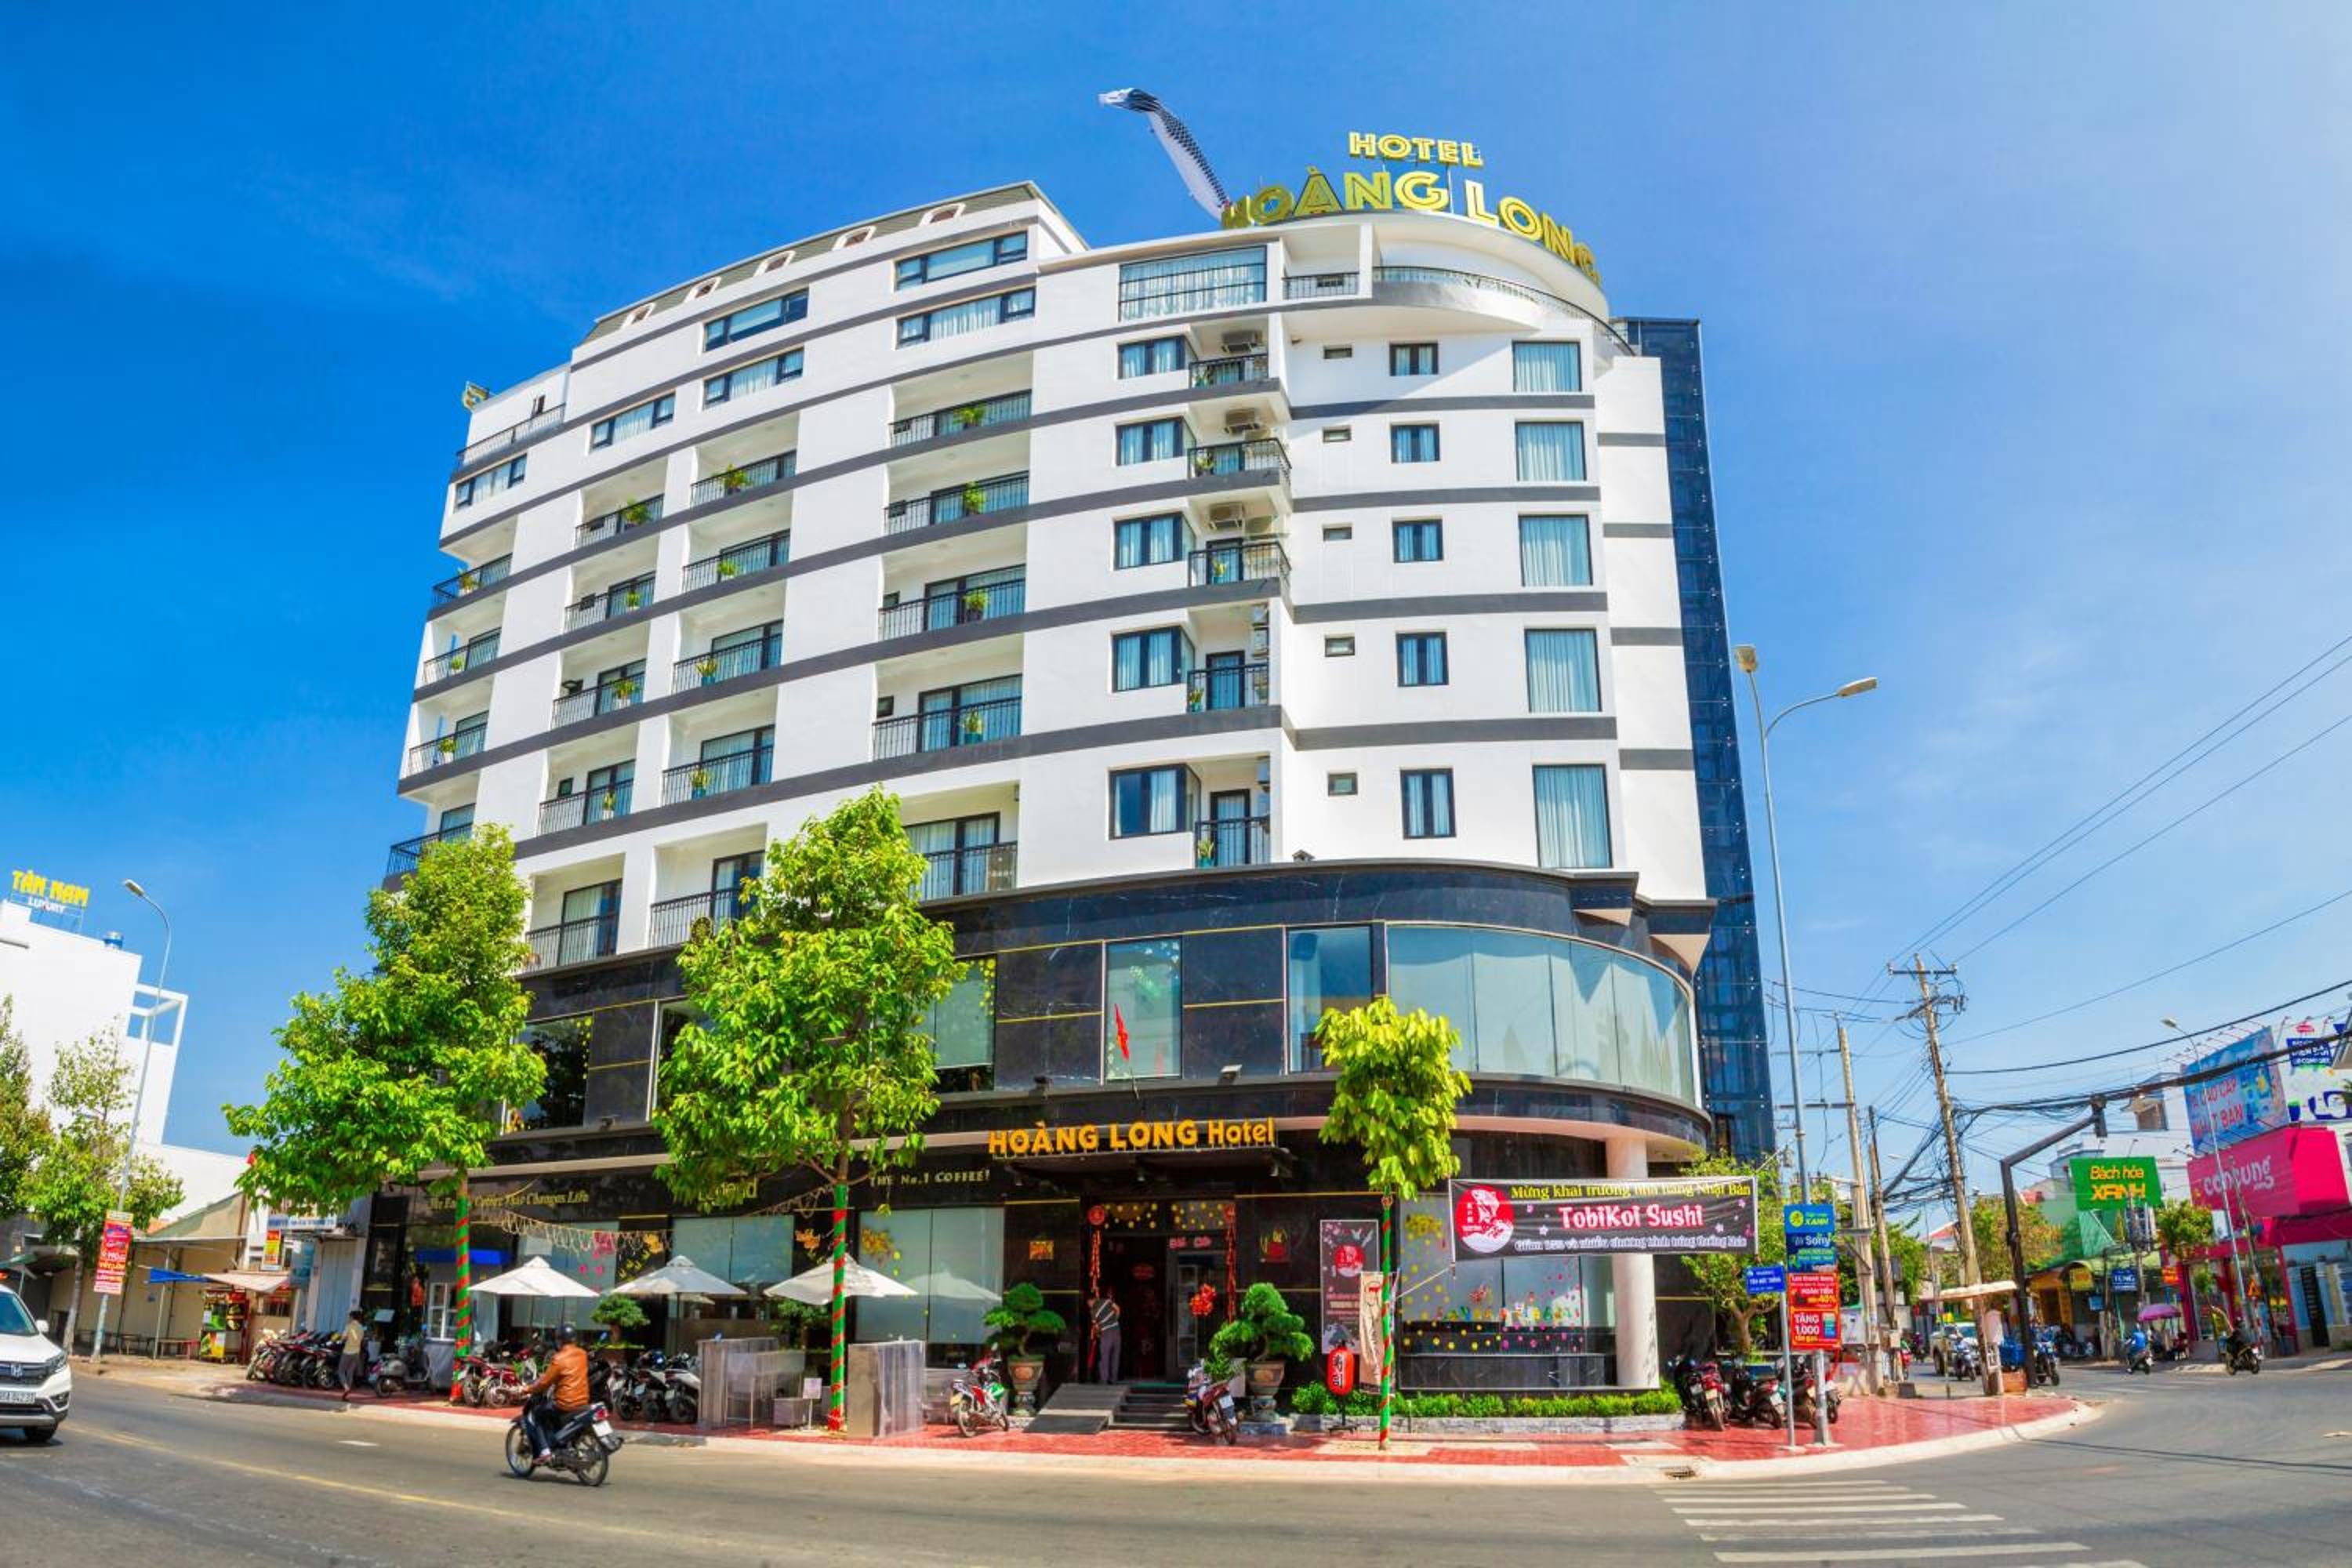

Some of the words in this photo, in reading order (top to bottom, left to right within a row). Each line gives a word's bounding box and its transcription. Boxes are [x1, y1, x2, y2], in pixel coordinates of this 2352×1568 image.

[1348, 131, 1483, 167] HOTEL
[1465, 179, 1602, 284] LONG
[988, 1121, 1099, 1155] HOÀNG
[1109, 1120, 1199, 1149] LONG
[1208, 1116, 1275, 1145] Hotel
[1558, 1204, 1641, 1229] TobiKoi
[1646, 1203, 1704, 1228] Sushi
